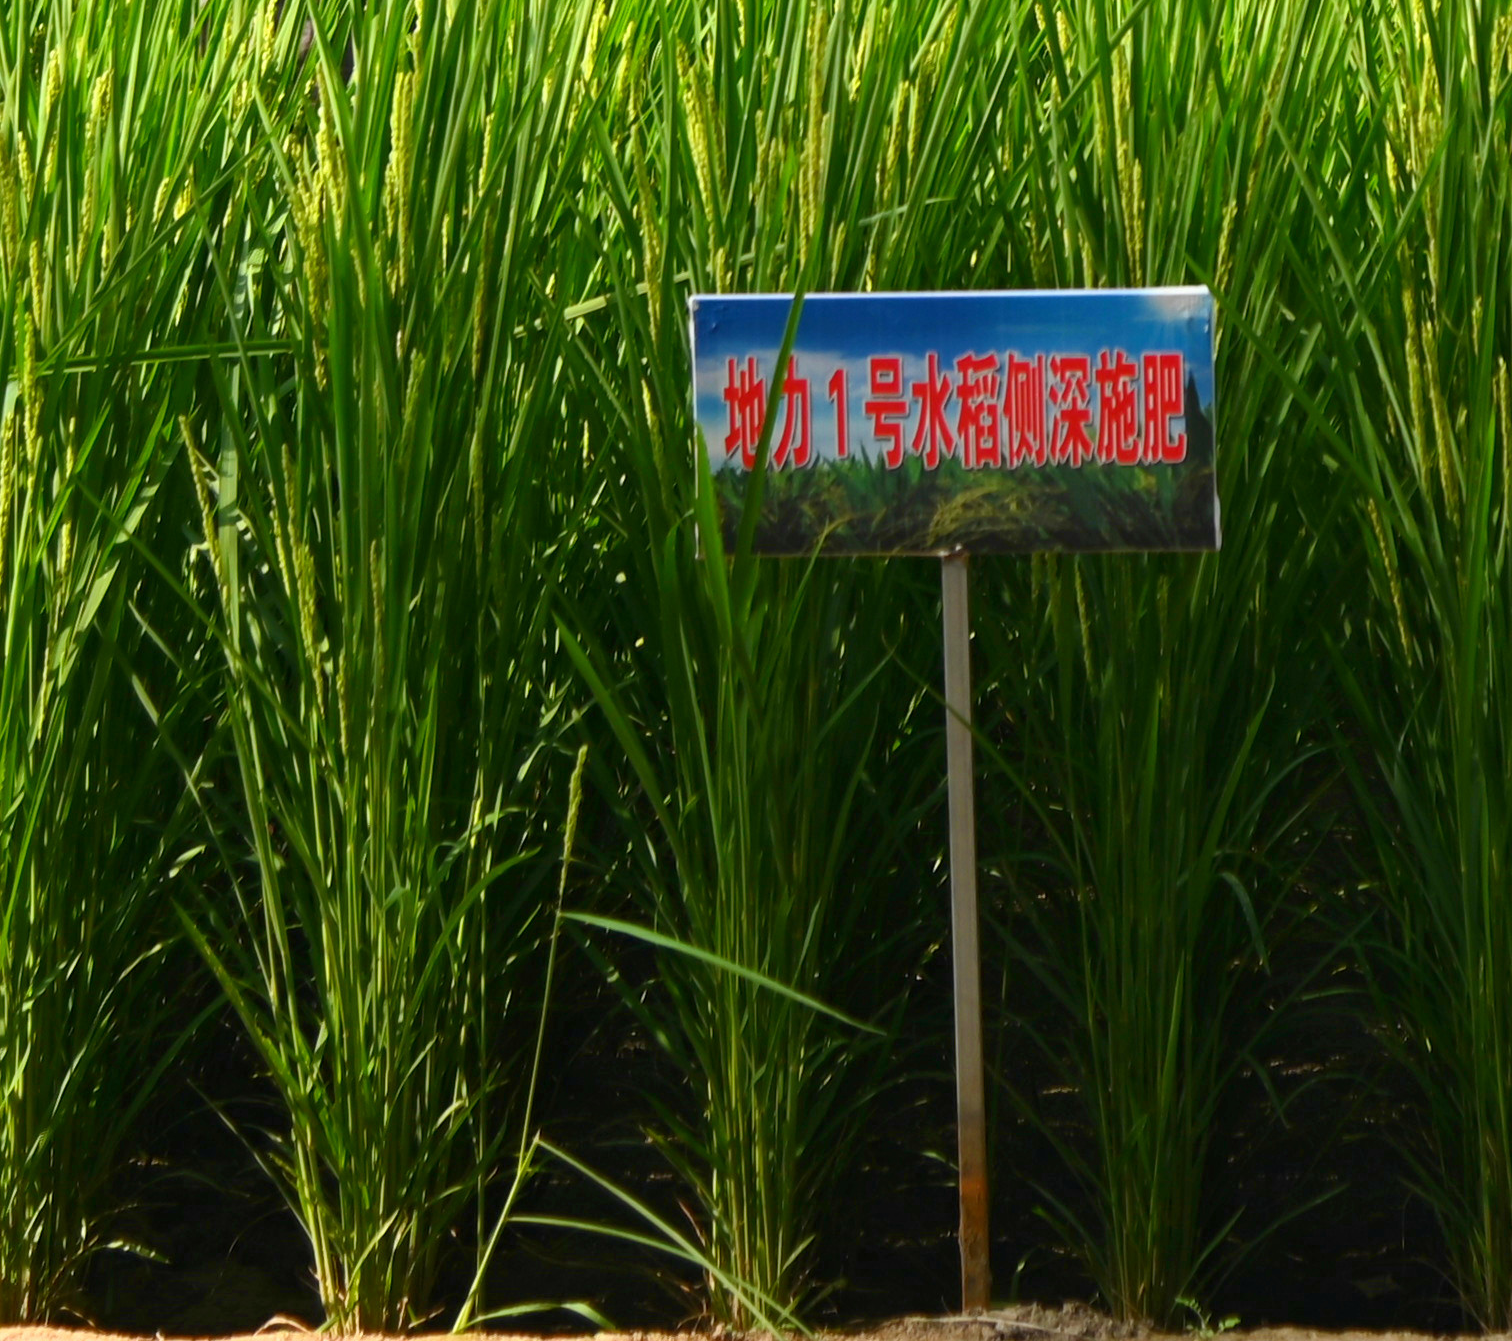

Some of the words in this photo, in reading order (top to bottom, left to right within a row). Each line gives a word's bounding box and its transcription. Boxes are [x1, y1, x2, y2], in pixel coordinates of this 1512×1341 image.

[723, 349, 1187, 470] 地力1号水稻侧深施肥
